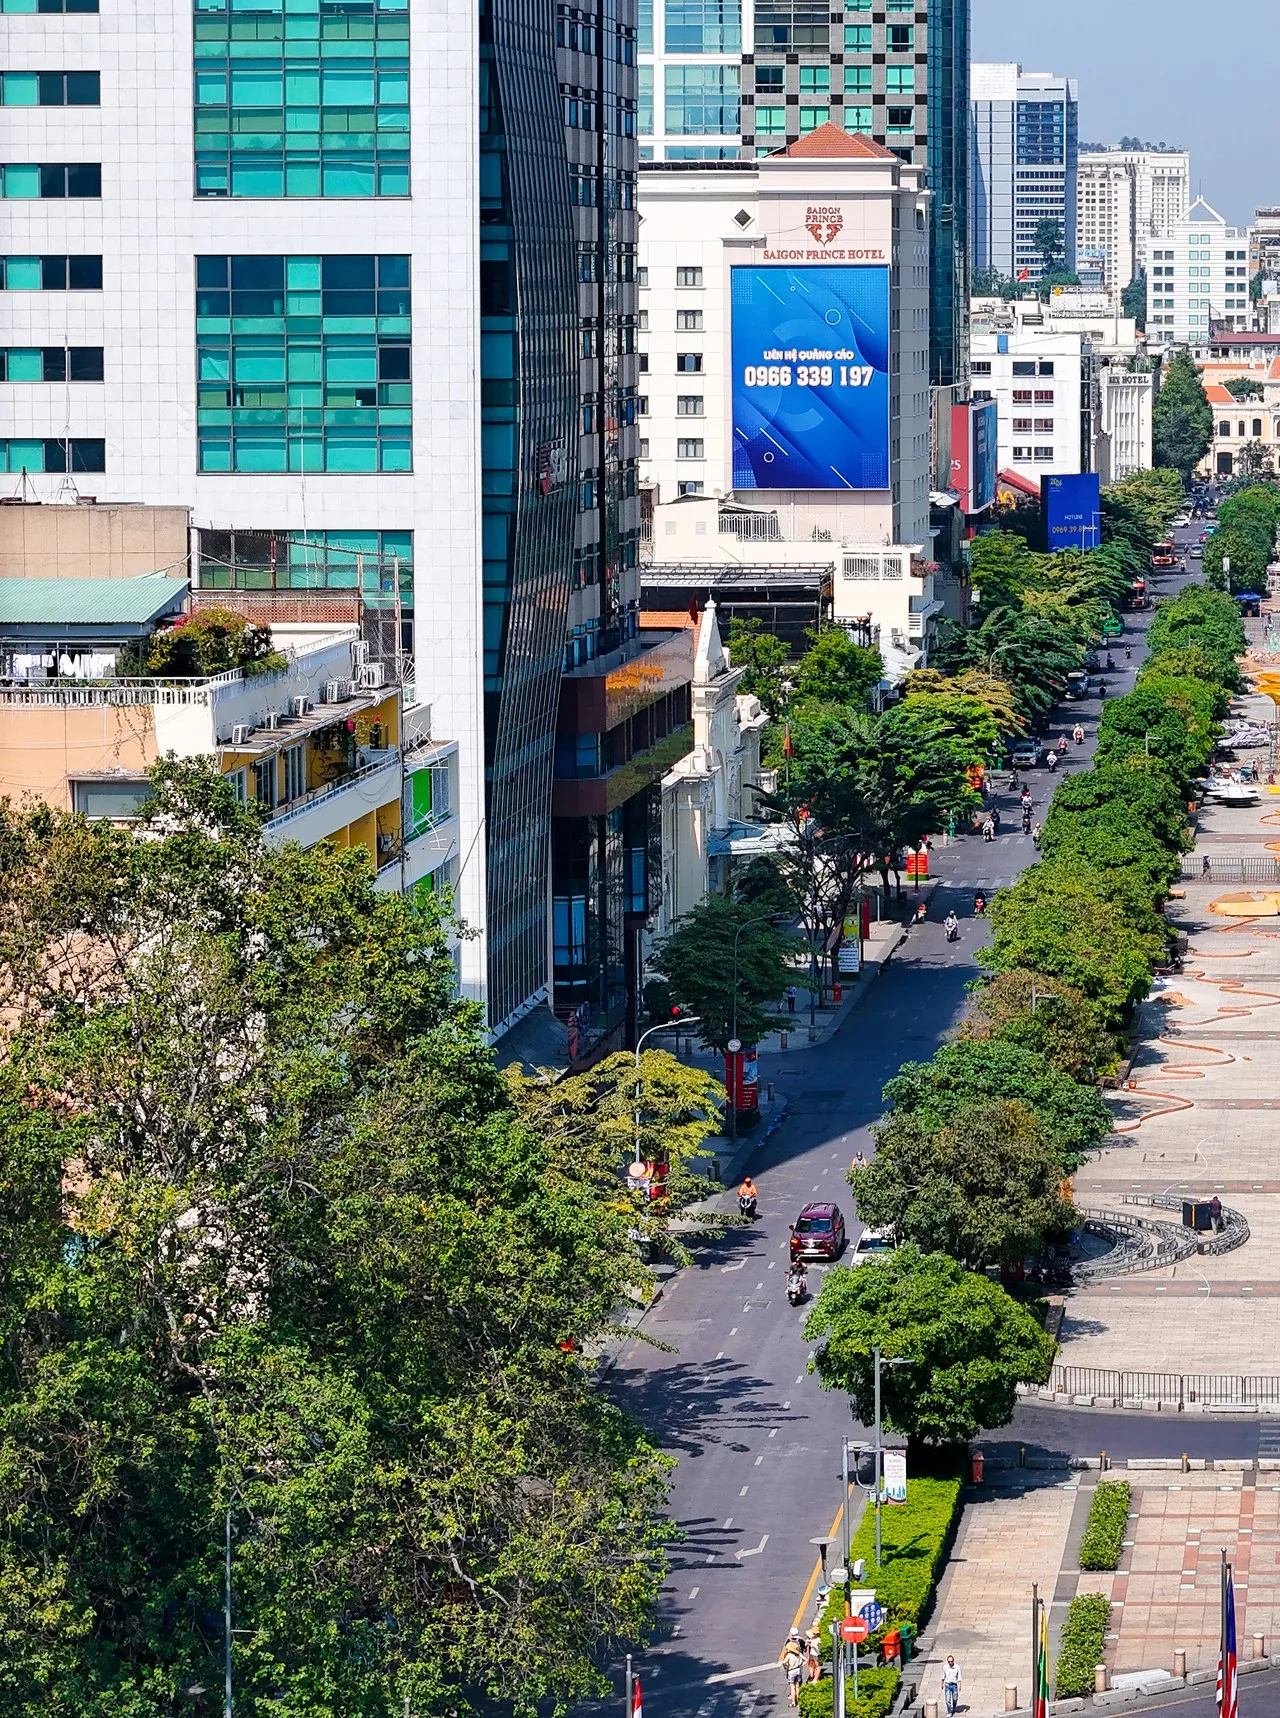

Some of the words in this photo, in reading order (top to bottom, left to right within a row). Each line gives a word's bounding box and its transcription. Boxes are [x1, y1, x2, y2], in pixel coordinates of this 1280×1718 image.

[806, 206, 841, 214] SAIGON
[805, 215, 843, 223] PRINCE
[763, 250, 804, 260] SAIGON
[806, 250, 845, 260] PRINCE
[847, 249, 885, 259] HOTEL
[763, 349, 784, 361] LIÊN
[784, 348, 798, 363] HỆ
[798, 348, 834, 361] QUẢNG
[834, 348, 855, 361] CÁO
[744, 366, 793, 387] 0966
[797, 366, 834, 387] 339
[840, 366, 875, 387] 197
[1121, 376, 1149, 384] HOTEL
